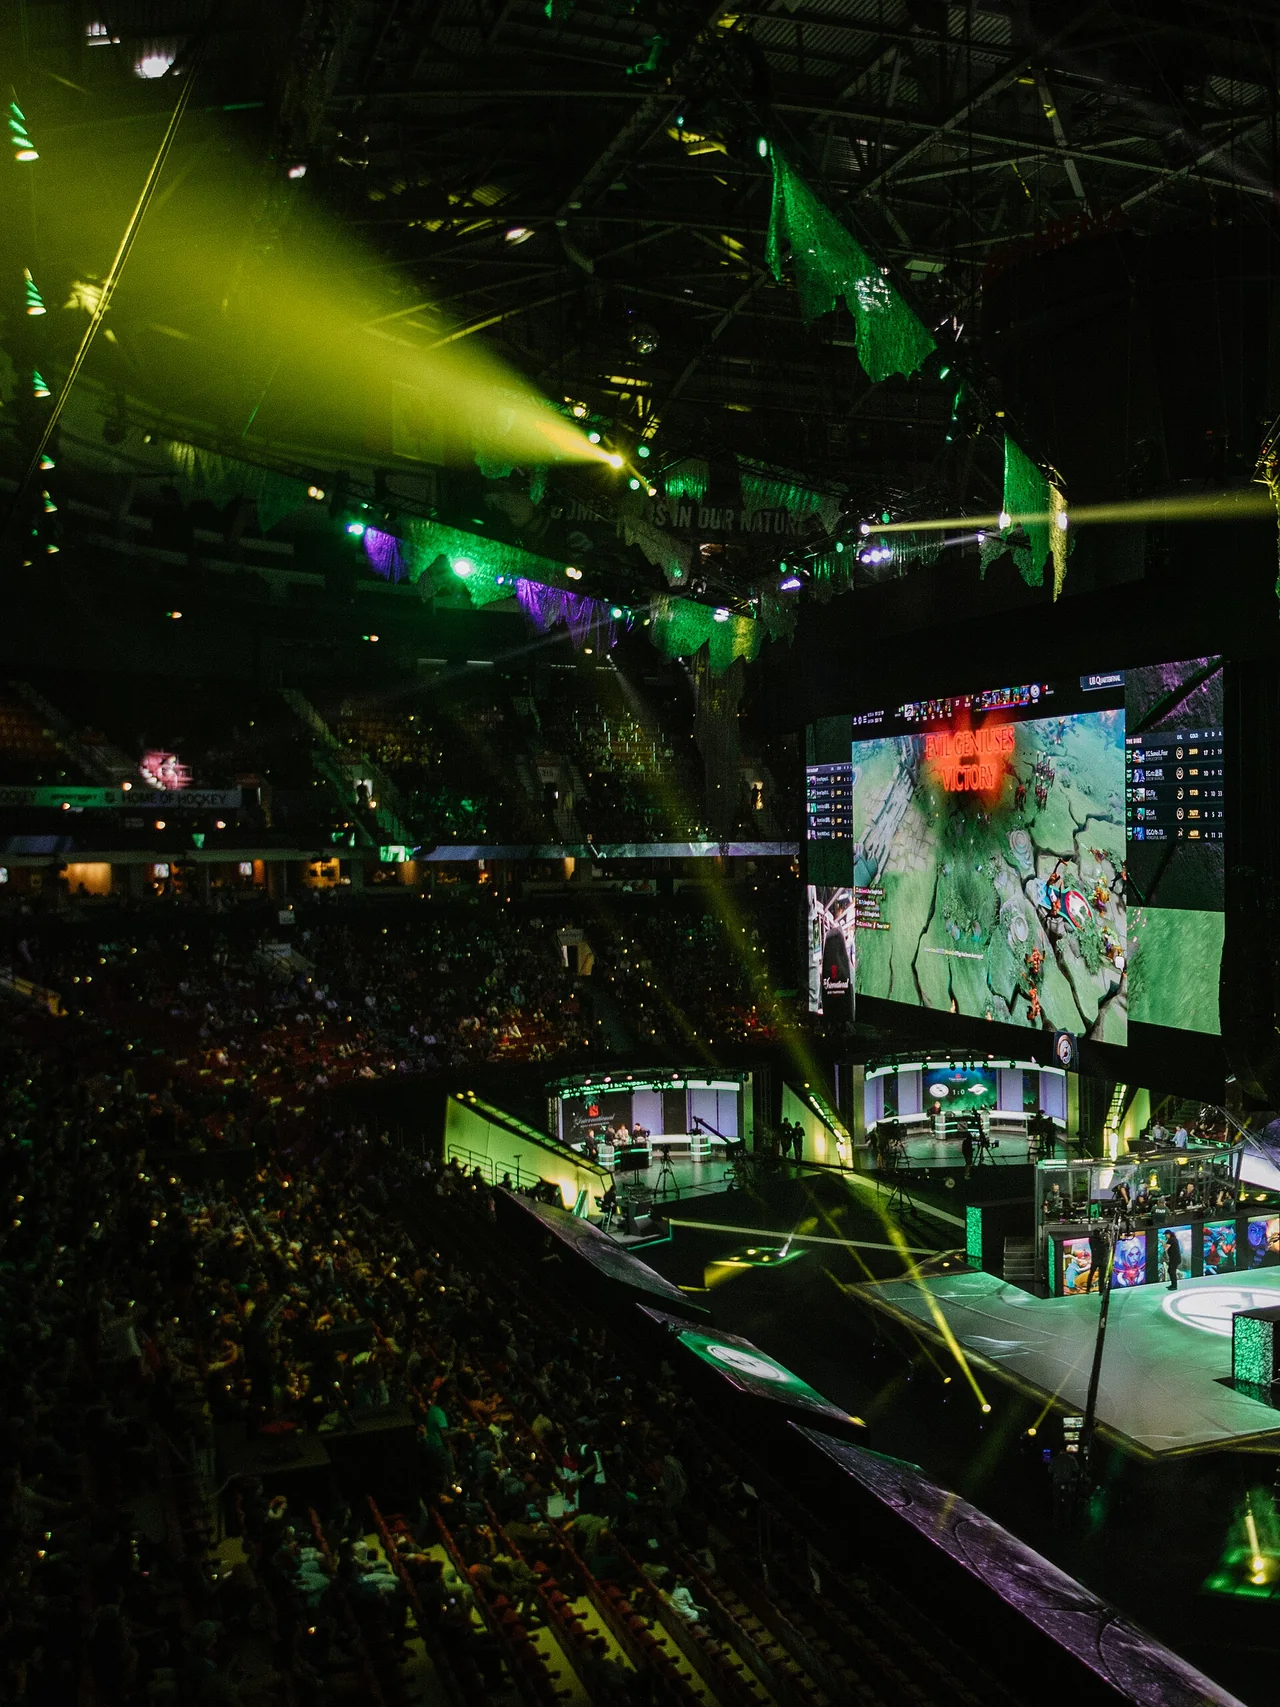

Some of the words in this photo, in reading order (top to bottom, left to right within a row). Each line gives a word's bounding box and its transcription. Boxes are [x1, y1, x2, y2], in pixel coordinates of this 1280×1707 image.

[672, 504, 692, 528] IN
[698, 507, 734, 531] OUR
[925, 733, 951, 761] EVIL
[953, 725, 1015, 757] GENIUSES
[941, 763, 997, 792] VICTORY
[178, 793, 227, 806] HOCKEY
